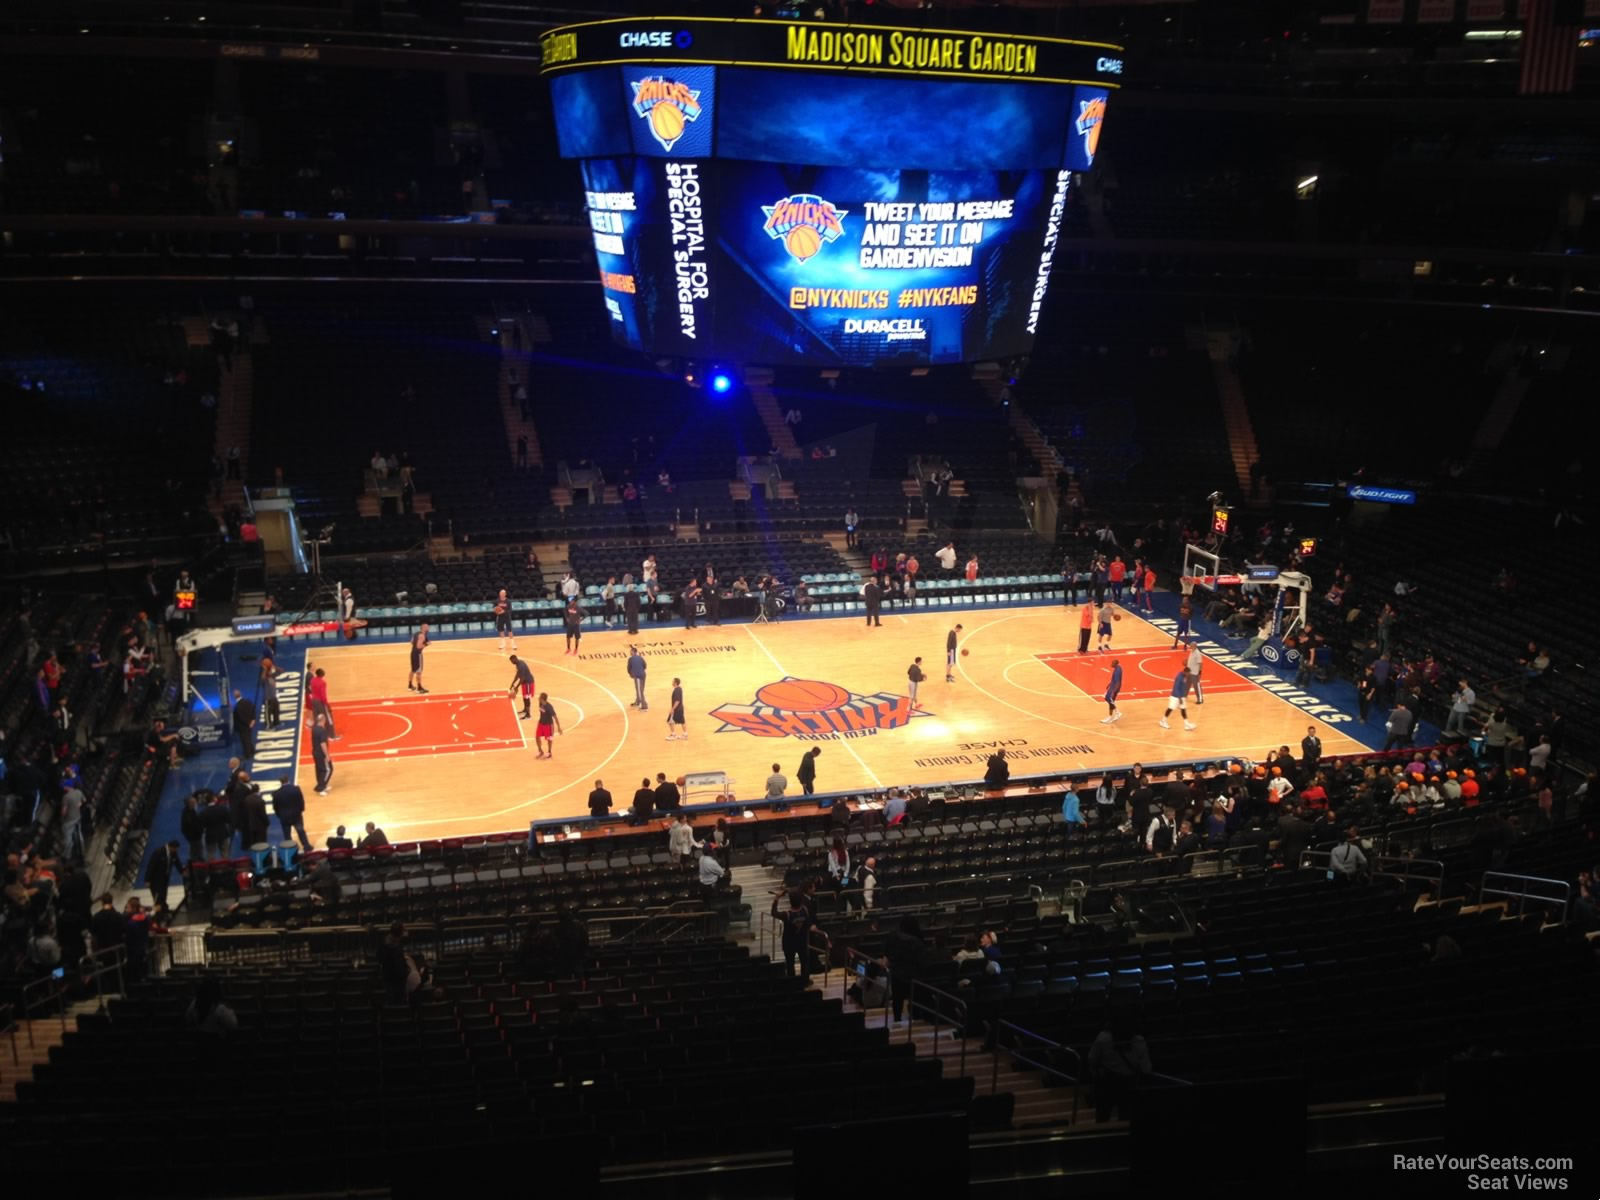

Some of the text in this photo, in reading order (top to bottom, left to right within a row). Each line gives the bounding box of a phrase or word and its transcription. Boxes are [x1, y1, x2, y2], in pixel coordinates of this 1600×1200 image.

[620, 32, 672, 47] CHASE
[787, 26, 1037, 73] MADISON SQUARE GARDEN
[767, 200, 841, 233] KNICKS
[864, 200, 1014, 221] TWEET YOUR MESSAGE
[681, 164, 709, 299] HOSPITAL FOR
[861, 222, 983, 246] AND SEE IT ON
[666, 163, 696, 339] SPECIAL SURGERY
[860, 246, 973, 268] GARDENVISION
[790, 285, 977, 309] @NYKNICKS #NYKFANS
[845, 319, 922, 333] DURACELL
[1378, 491, 1411, 500] LIGHT
[237, 623, 263, 631] CHASE
[578, 645, 736, 661] MADISON SQUAR GARDEN
[625, 640, 684, 648] CHASE
[1196, 641, 1258, 670] YORK
[1248, 674, 1352, 724] KNICKS
[709, 694, 911, 737] KNICKS
[795, 727, 877, 742] NEW YORK
[959, 739, 1028, 750] CHASE
[252, 728, 295, 773] YORK
[1032, 744, 1095, 758] MADISON
[915, 755, 972, 768] GARDEN
